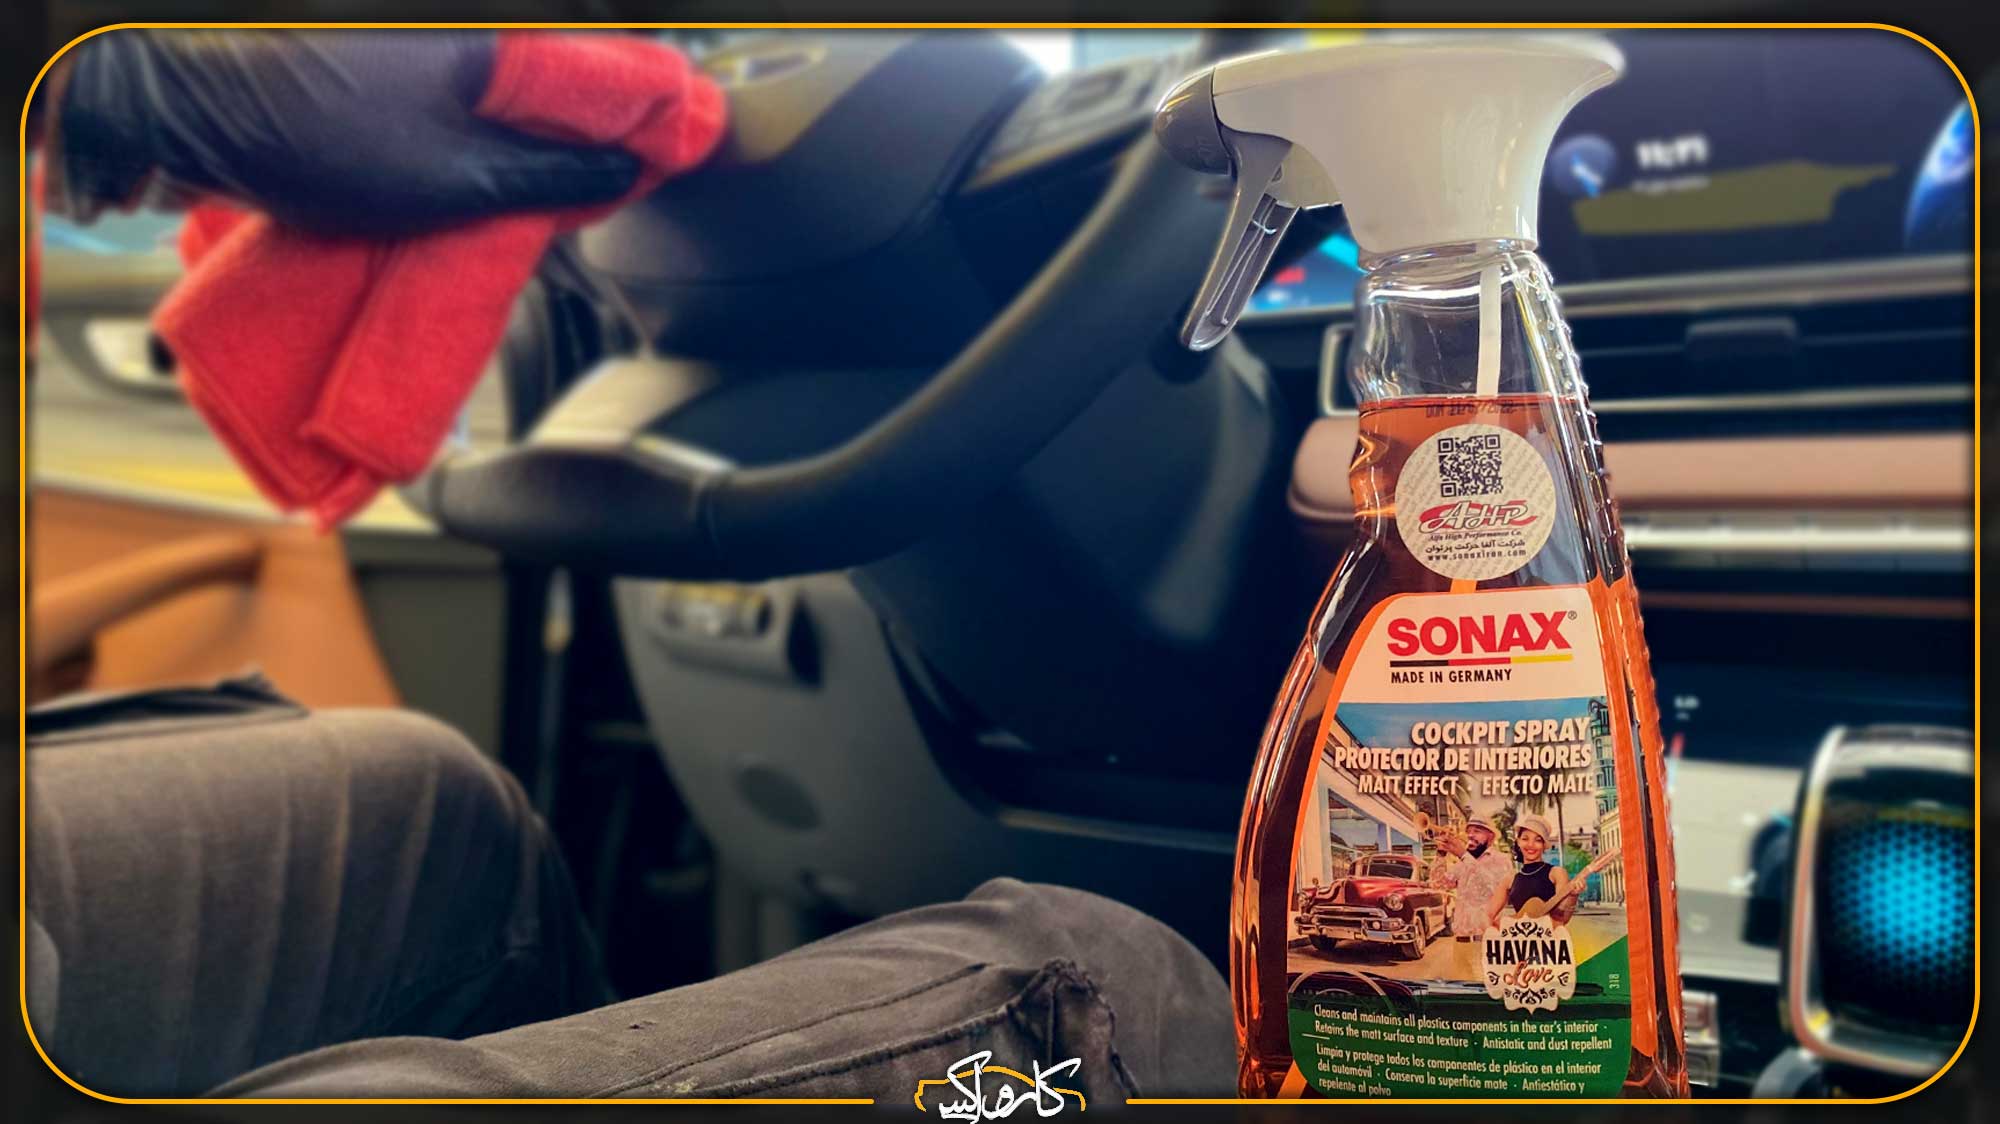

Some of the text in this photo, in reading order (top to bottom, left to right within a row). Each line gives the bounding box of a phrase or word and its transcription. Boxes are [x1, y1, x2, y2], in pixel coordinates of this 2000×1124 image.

[1445, 533, 1462, 541] High
[1464, 531, 1509, 540] Performance
[1428, 549, 1527, 560] www.sonaxiran.com
[1387, 611, 1572, 656] SONAX
[1391, 669, 1512, 684] MADE IN GERMANY
[1411, 717, 1591, 746] COCKPIT SPRAY
[1335, 744, 1592, 771] PROTECTOR DE INTERIORES
[1359, 773, 1594, 796] MATT EFFECT EFECTO MATE
[1486, 940, 1571, 965] HAVANA
[1503, 960, 1554, 988] Love
[1609, 973, 1620, 989] 318
[1314, 1004, 1598, 1033] Cleans and maintains all plastics components in the car's interior
[1315, 1020, 1612, 1053] Retains the matt surface and texture Antistatic and dust repellent
[1316, 1043, 1601, 1075] Limpia y protege todos los componentes de plástico en el interior
[1318, 1058, 1585, 1094] del automóvil Conserva la superficie mate Antiestático y
[1319, 1077, 1392, 1097] repelente al polvo
